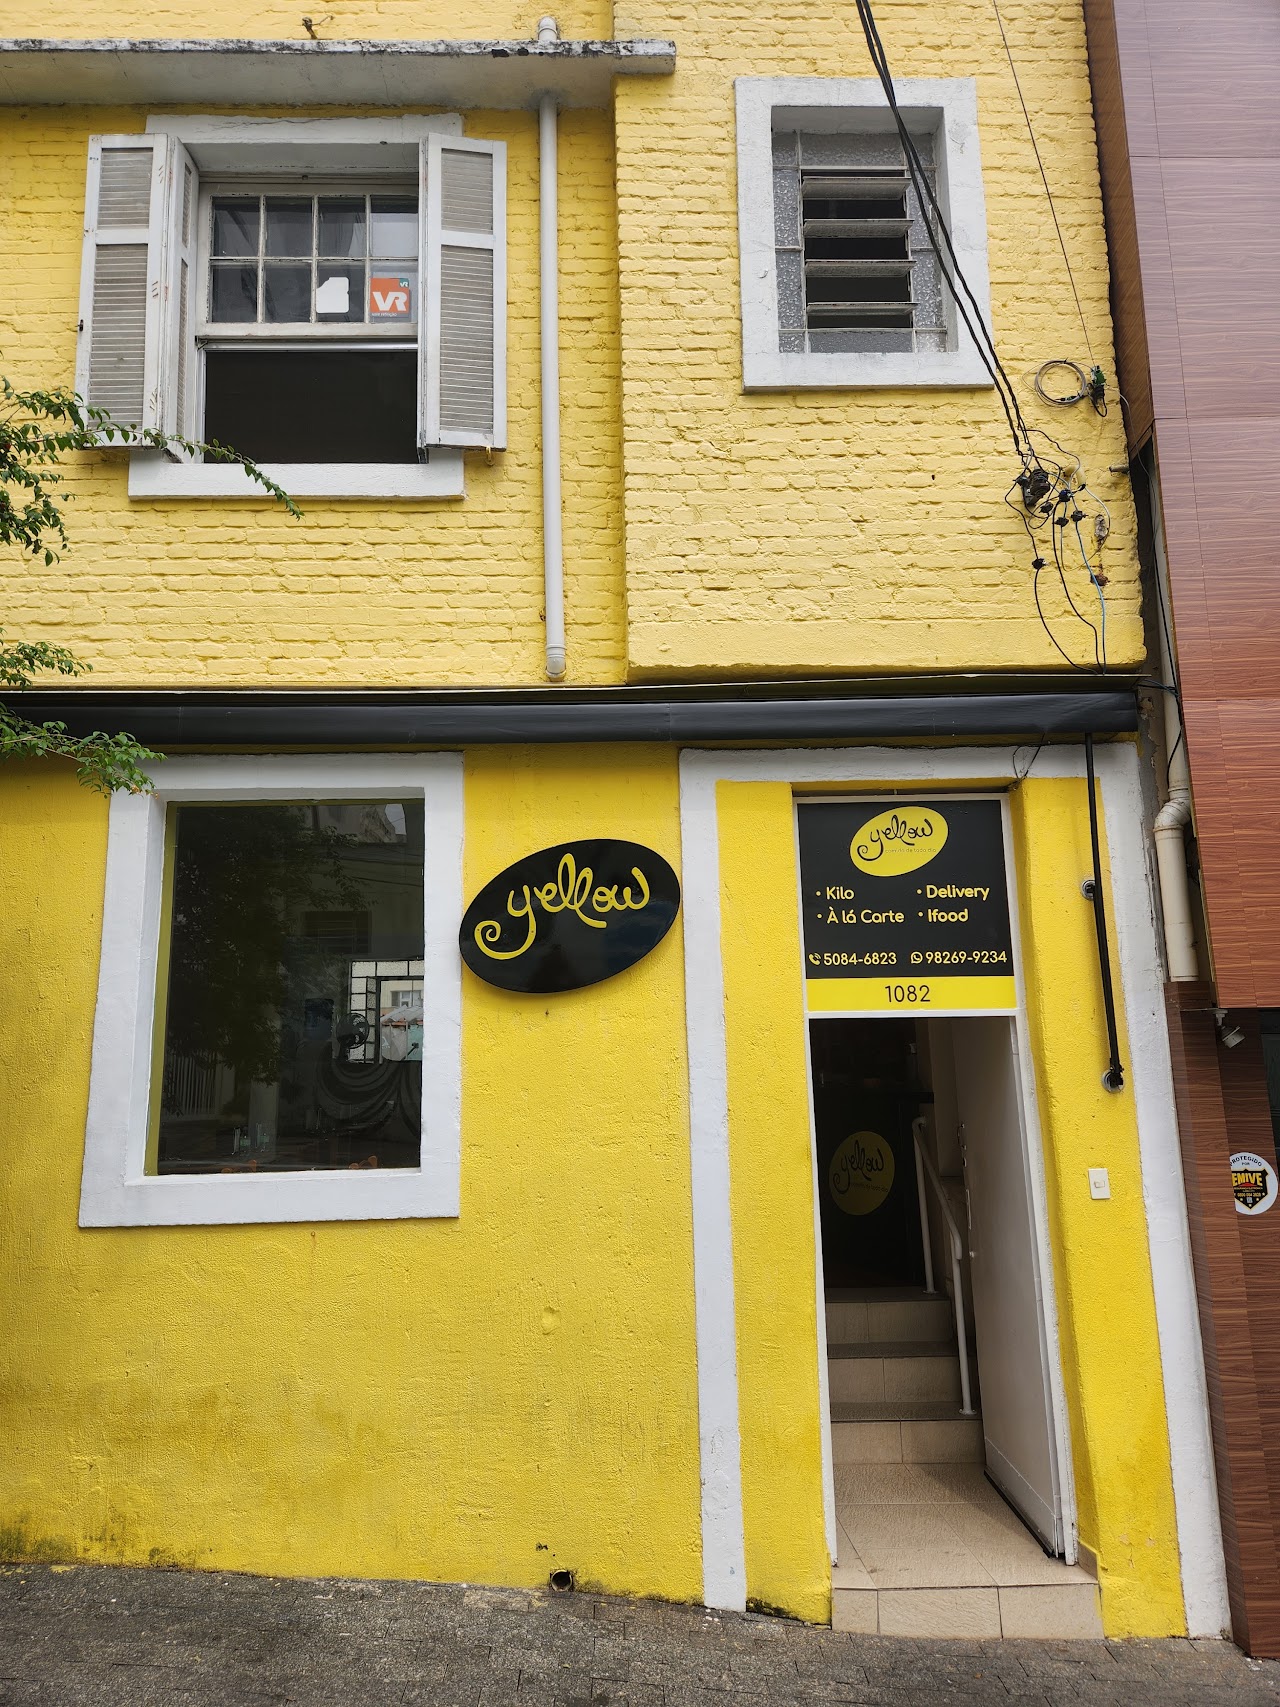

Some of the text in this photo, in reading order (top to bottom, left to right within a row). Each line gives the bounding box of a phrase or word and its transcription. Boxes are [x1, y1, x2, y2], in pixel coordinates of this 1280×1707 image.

[372, 291, 407, 311] VR
[857, 814, 933, 861] yellow
[826, 886, 855, 900] Kilo
[926, 885, 990, 901] Delivery
[474, 852, 650, 960] yellow
[827, 906, 839, 924] À
[860, 909, 905, 923] Carte
[928, 908, 969, 922] Ifood
[824, 952, 897, 966] 5084-6823
[925, 951, 1007, 964] 98269-9234
[885, 984, 931, 1003] 1082
[833, 1140, 884, 1194] yellow
[1231, 1173, 1263, 1186] EMIVE
